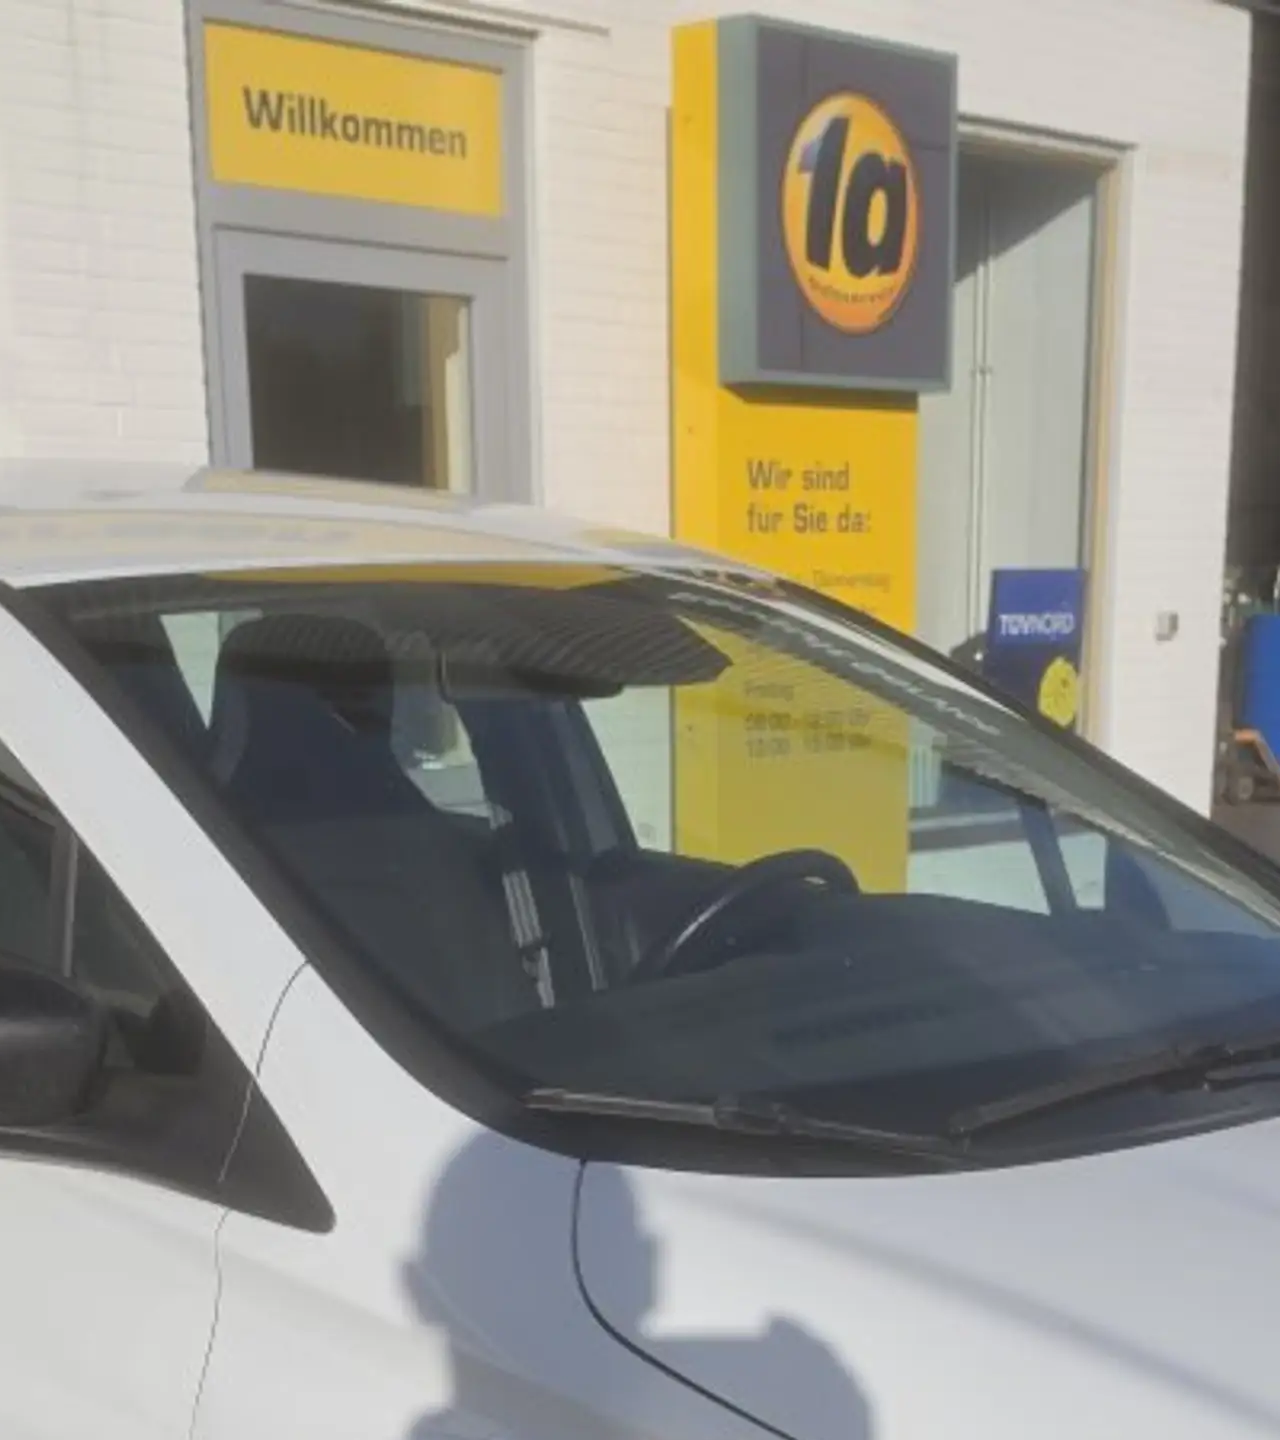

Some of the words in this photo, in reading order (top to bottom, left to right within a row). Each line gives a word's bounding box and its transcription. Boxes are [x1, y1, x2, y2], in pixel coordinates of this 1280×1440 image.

[241, 84, 468, 160] Willkommen
[746, 459, 792, 491] Wir
[801, 461, 850, 491] sind
[793, 503, 828, 534] Sie
[836, 504, 872, 534] da:
